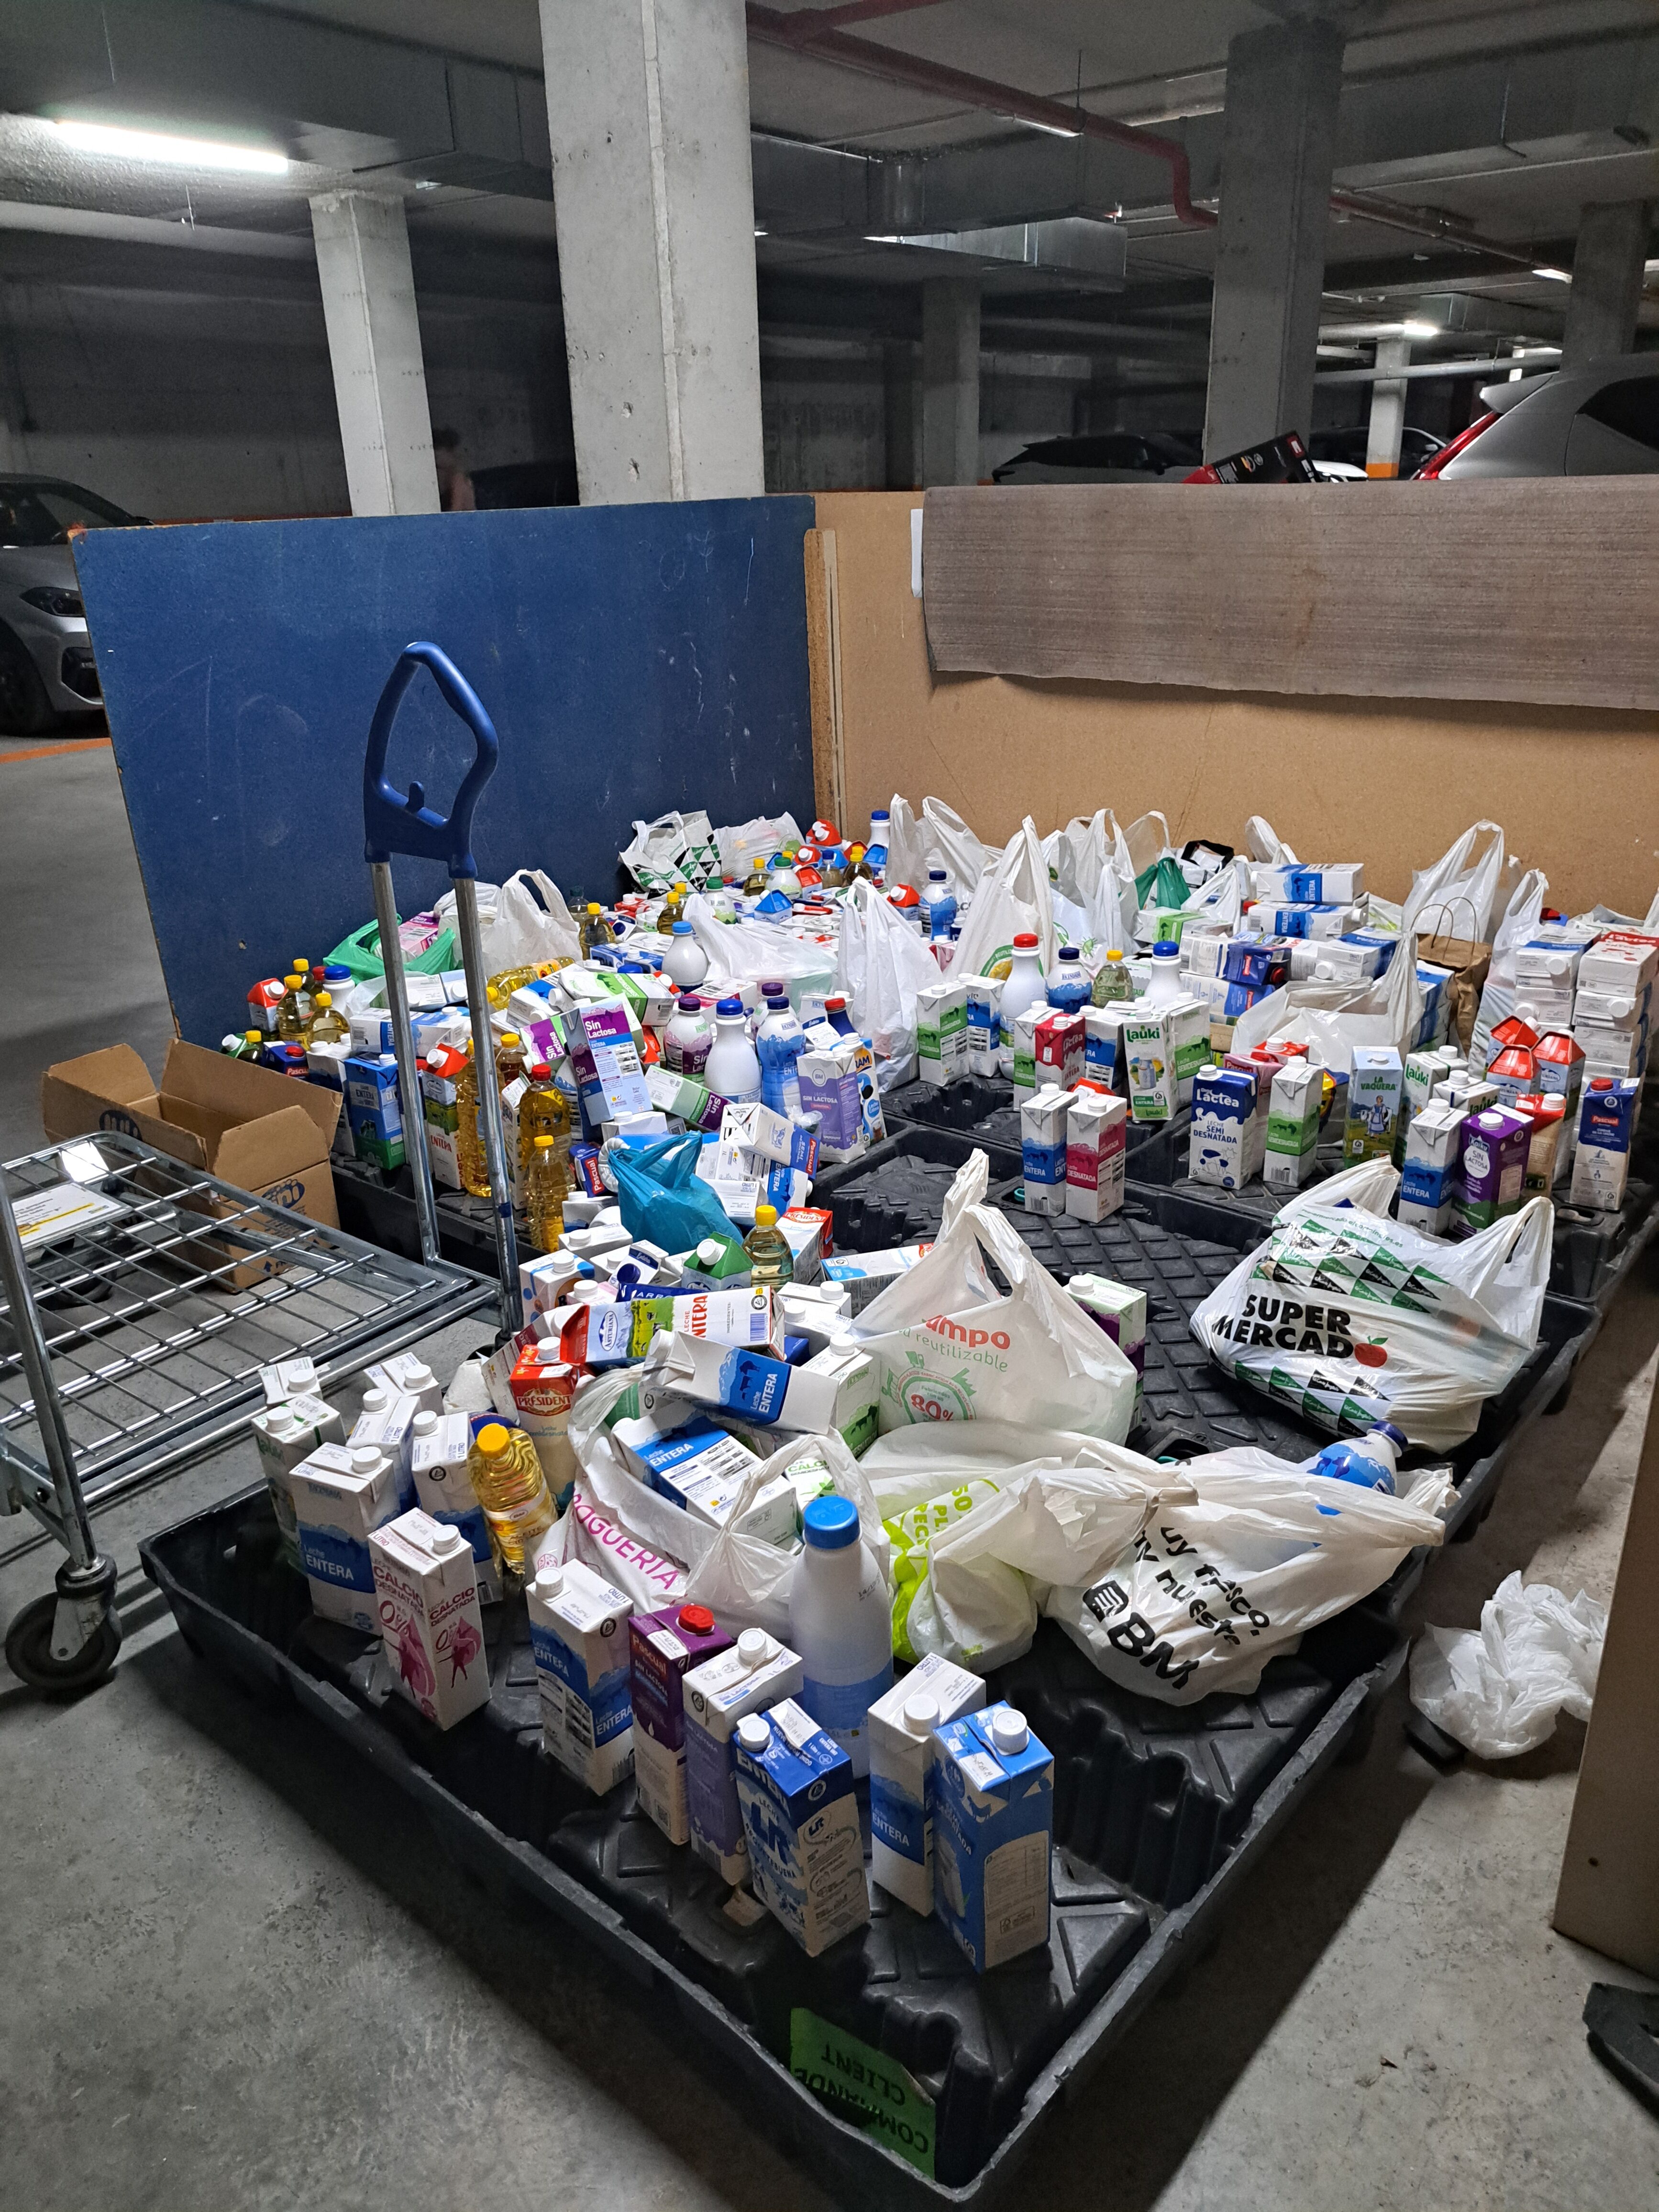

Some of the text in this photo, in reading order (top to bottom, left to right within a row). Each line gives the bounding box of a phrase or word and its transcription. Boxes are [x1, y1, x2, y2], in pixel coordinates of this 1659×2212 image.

[585, 1020, 601, 1030] Sin
[587, 1028, 617, 1039] Lactosa
[547, 1045, 556, 1060] Sin
[550, 1031, 564, 1057] Lactosa
[575, 1065, 586, 1075] Sin
[578, 1072, 598, 1084] Lactosa
[699, 1095, 716, 1124] Lactosa
[710, 1097, 721, 1114] Sin
[1206, 1125, 1224, 1134] SEMI
[1593, 1116, 1619, 1125] Pascual
[1194, 1129, 1238, 1144] DESNATADA
[807, 1139, 817, 1175] Pascual
[1465, 1156, 1488, 1170] LACTOSA
[1472, 1150, 1484, 1161] SIN
[587, 1159, 602, 1192] Pascual
[773, 1162, 782, 1192] ENTERA
[1024, 1166, 1046, 1176] ENTERA
[1067, 1169, 1096, 1183] DESNATADA
[1403, 1185, 1430, 1199] ENTERA
[1242, 1294, 1352, 1336] SUPER
[605, 1313, 614, 1351] ASTURIANA
[917, 1333, 1008, 1372] reutilizable
[517, 1394, 571, 1407] PRÉSIDENT
[750, 1391, 762, 1411] Leche
[759, 1373, 778, 1414] ENTERA
[644, 1449, 664, 1460] Leche
[649, 1443, 694, 1467] ENTERA
[306, 1554, 354, 1580] ENTERA
[374, 1565, 423, 1609] CALCIO
[376, 1580, 424, 1623] DESNATADA
[430, 1587, 475, 1620] CALCIO
[431, 1594, 476, 1626] DESNATADA
[534, 1649, 569, 1677] ENTERA
[632, 1636, 666, 1672] Pascual
[596, 1706, 633, 1736] ENTERA
[872, 1814, 909, 1847] ENTERA
[821, 2044, 906, 2106] CLIENT
[793, 2067, 929, 2154] COMNDE
